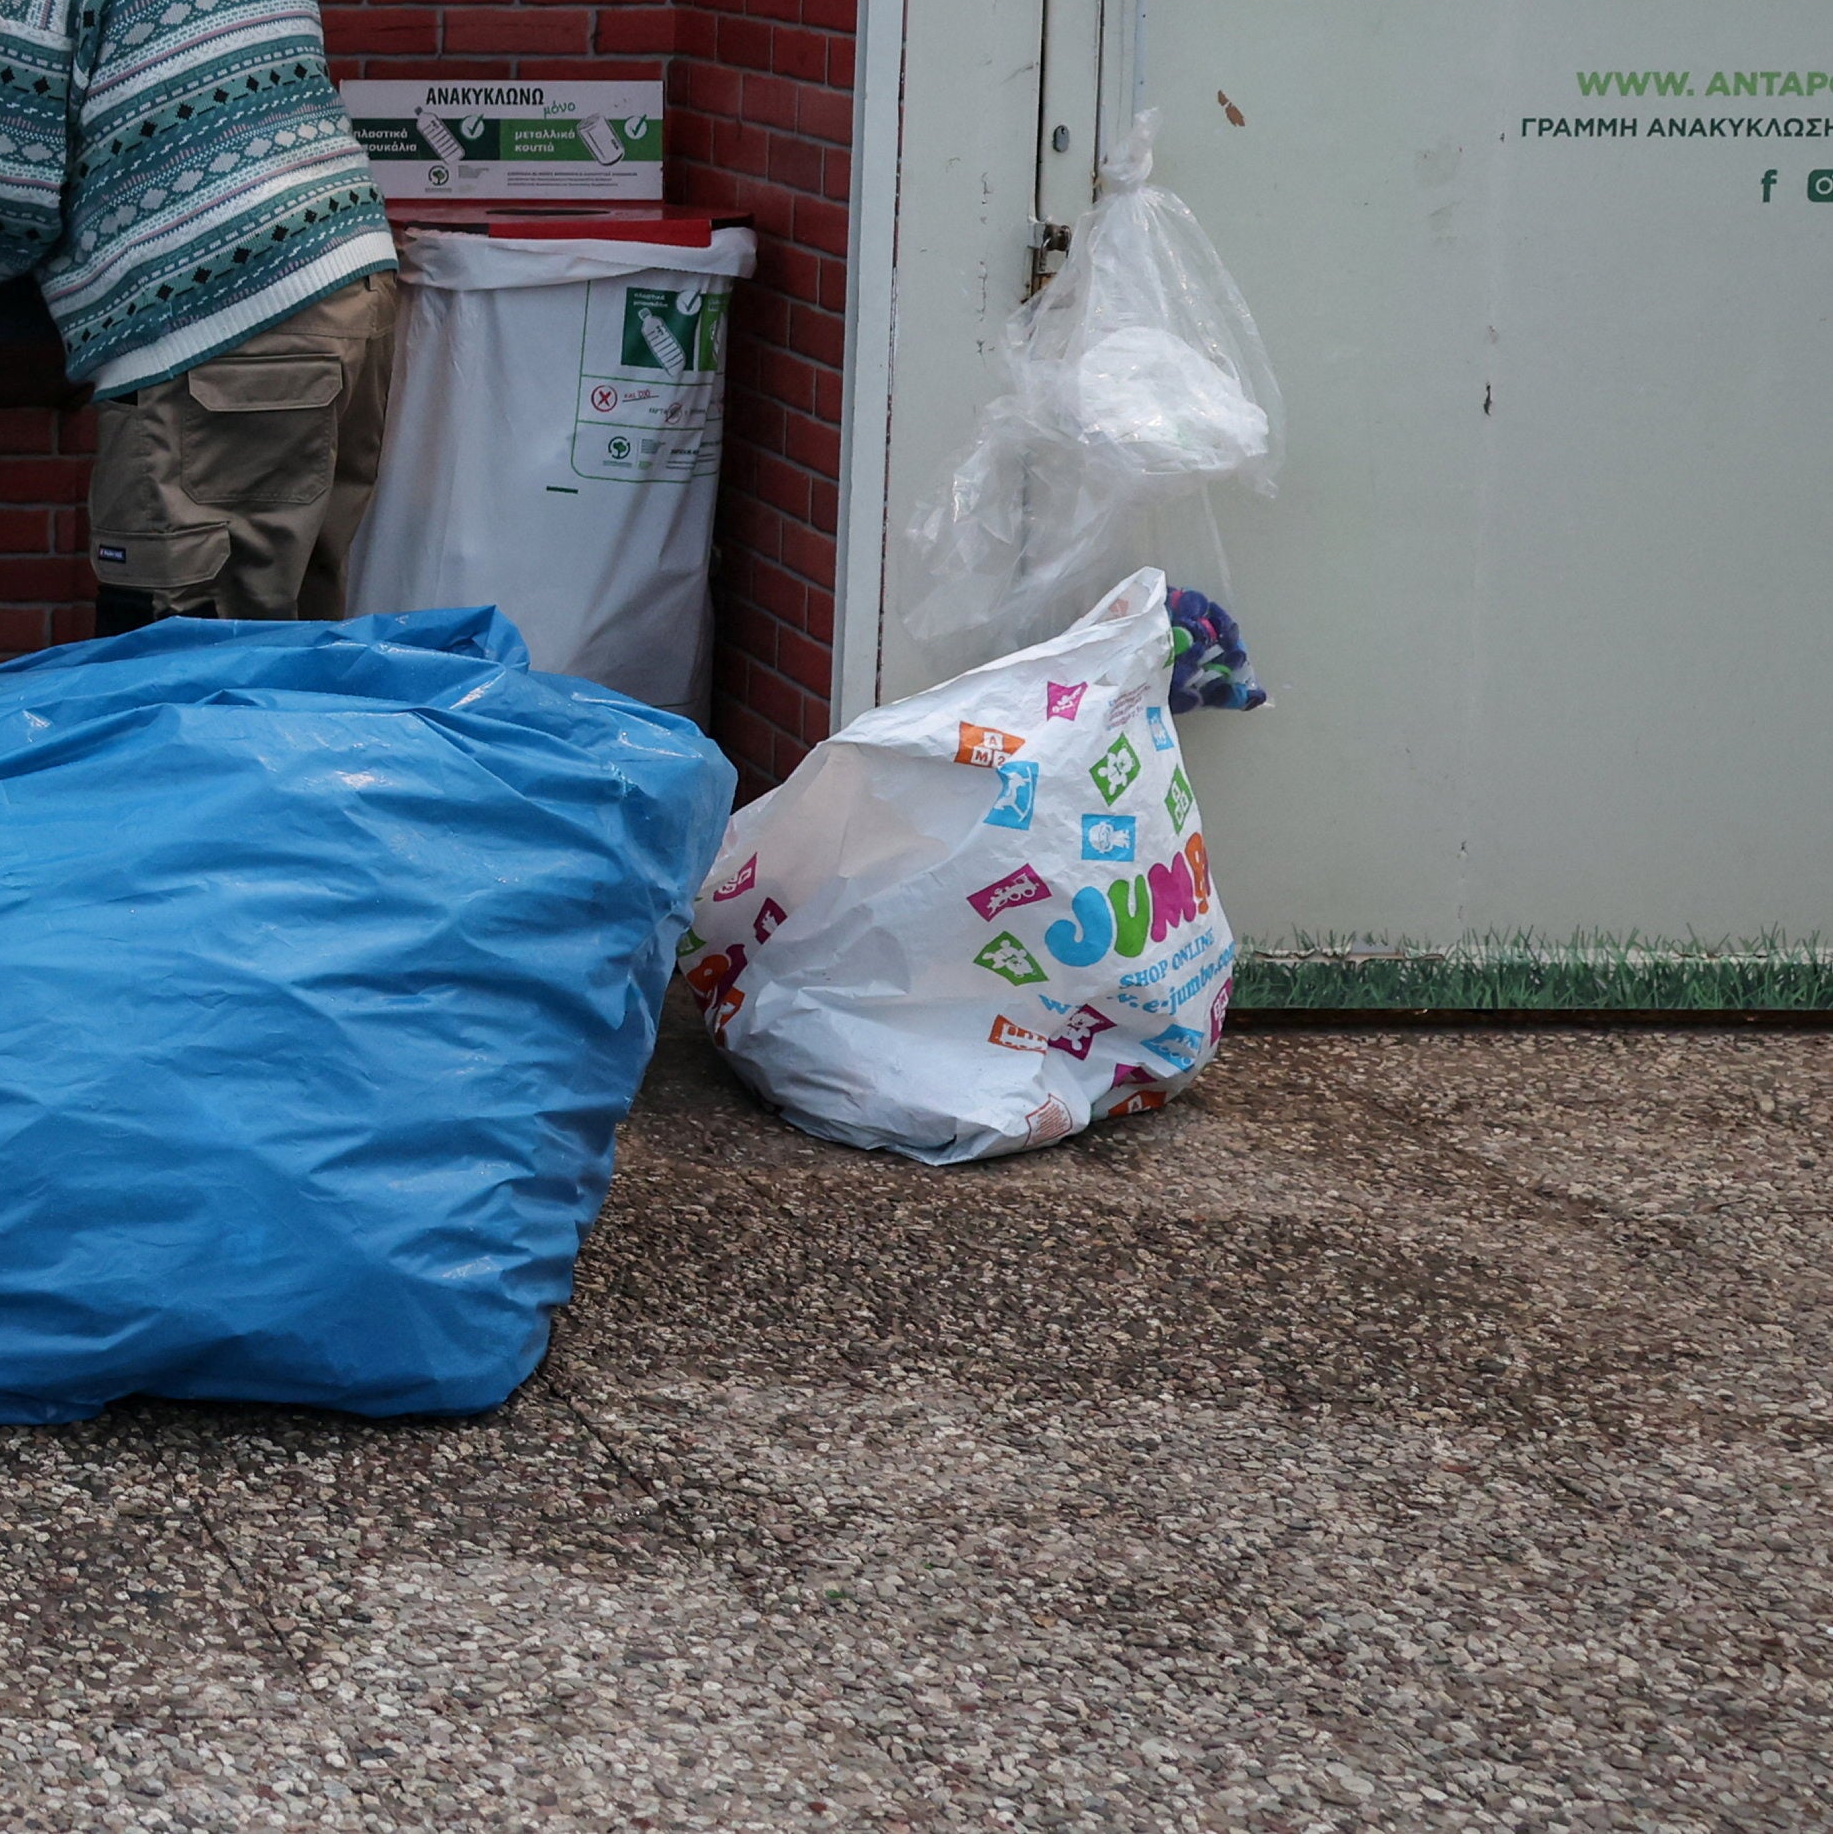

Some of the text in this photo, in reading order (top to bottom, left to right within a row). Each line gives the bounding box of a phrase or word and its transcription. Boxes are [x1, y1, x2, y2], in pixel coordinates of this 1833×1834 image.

[1577, 71, 1833, 96] WWW. ANTAP
[426, 87, 544, 106] ΑΝΑΚΥΚΛΩΝΩ
[543, 102, 576, 118] μόνο
[515, 129, 576, 140] μεταλλικά
[1521, 118, 1637, 137] ΓΡΑΜΜΗ
[362, 141, 417, 152] ουκάλια
[515, 142, 555, 153] κουτιά
[1119, 959, 1169, 989] SHOP
